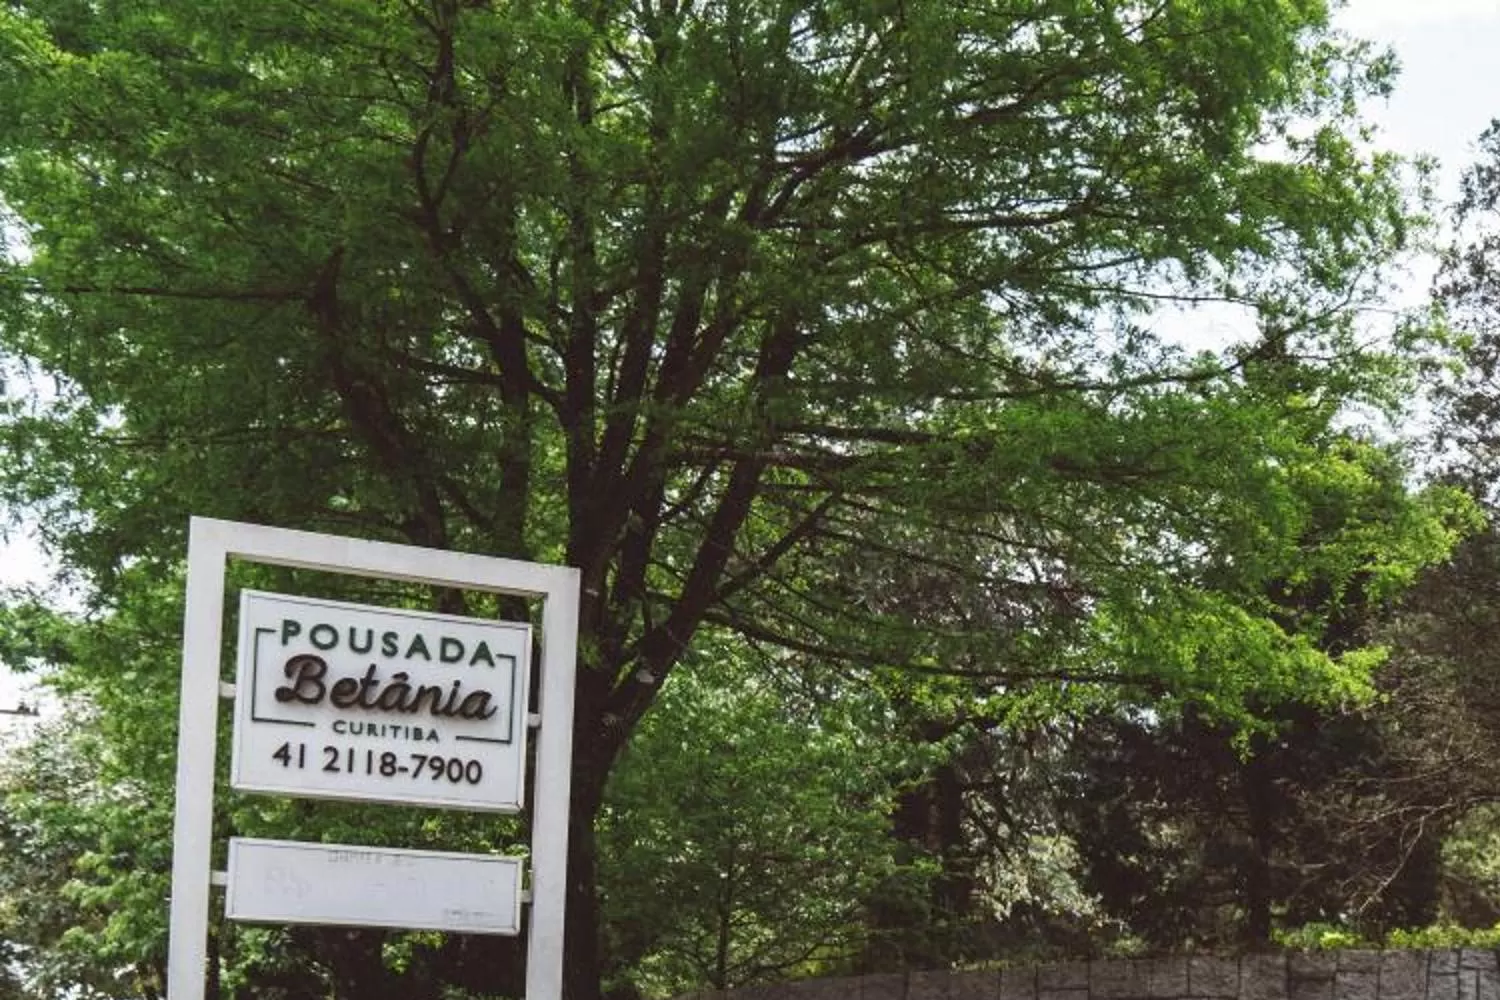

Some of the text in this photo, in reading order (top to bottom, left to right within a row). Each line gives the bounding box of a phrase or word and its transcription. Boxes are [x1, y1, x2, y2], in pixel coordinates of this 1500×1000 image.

[281, 620, 496, 667] POUSADA
[275, 654, 497, 720] Betânia
[333, 720, 440, 742] CURITIBA
[272, 743, 483, 784] 41 2118-7900
